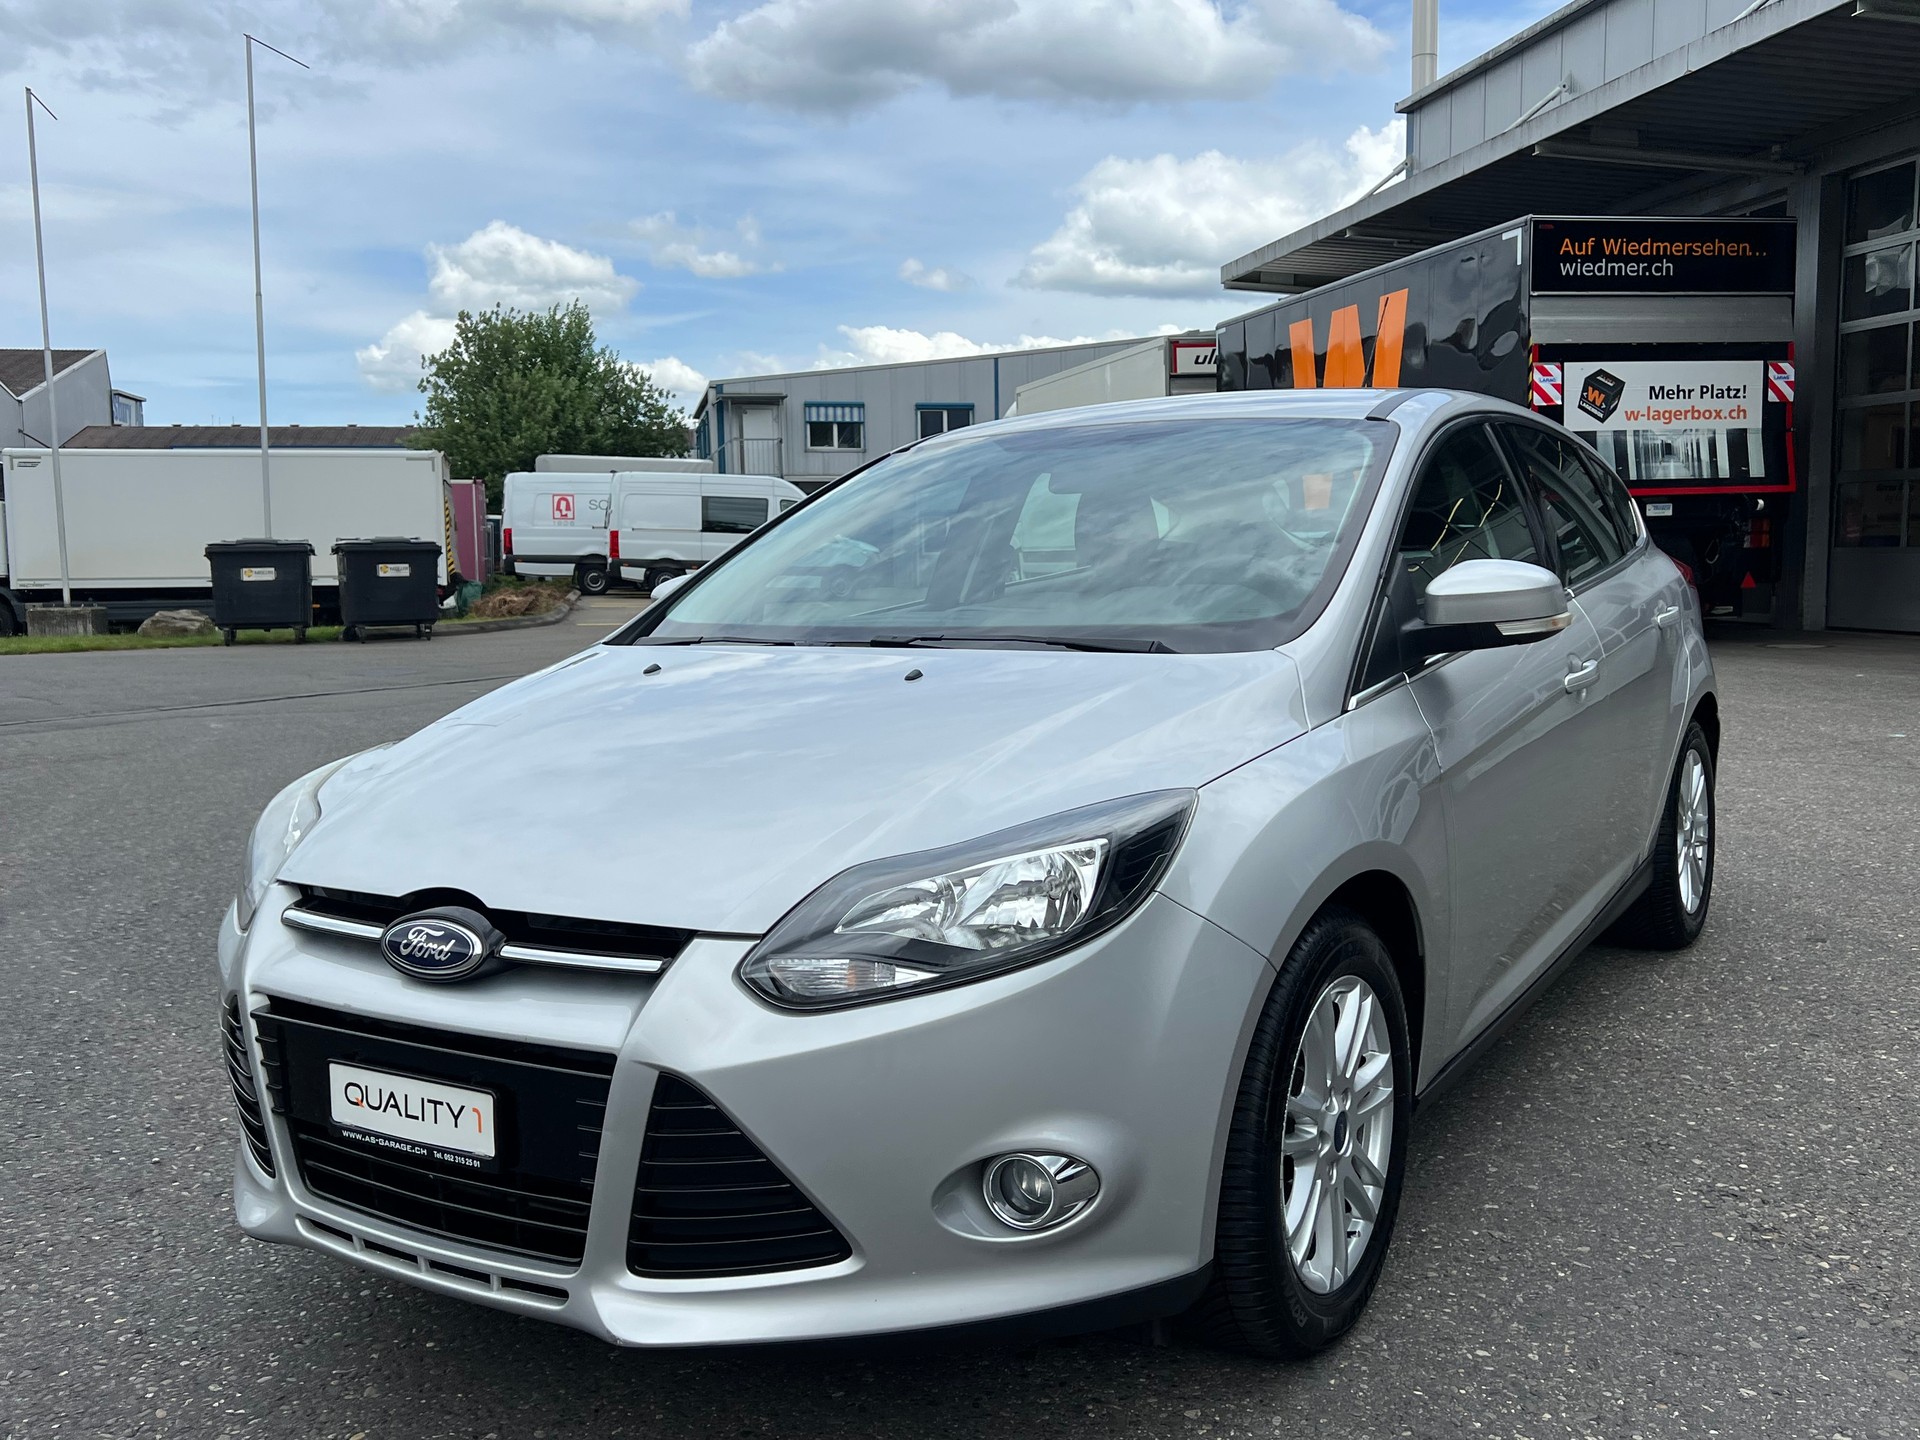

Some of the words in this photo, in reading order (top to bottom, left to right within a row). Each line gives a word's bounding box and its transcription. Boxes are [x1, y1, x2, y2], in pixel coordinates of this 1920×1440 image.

[1560, 238, 1595, 256] Auf
[1602, 238, 1767, 257] Wiedmersehen...
[1560, 258, 1674, 276] wiedmer.ch
[1649, 384, 1695, 400] Mehr
[1700, 384, 1747, 399] Platz!
[1624, 404, 1748, 425] w-lagerbox.ch
[400, 926, 455, 961] Ford
[342, 1129, 427, 1156] WWW.AS-GARAGE.CH
